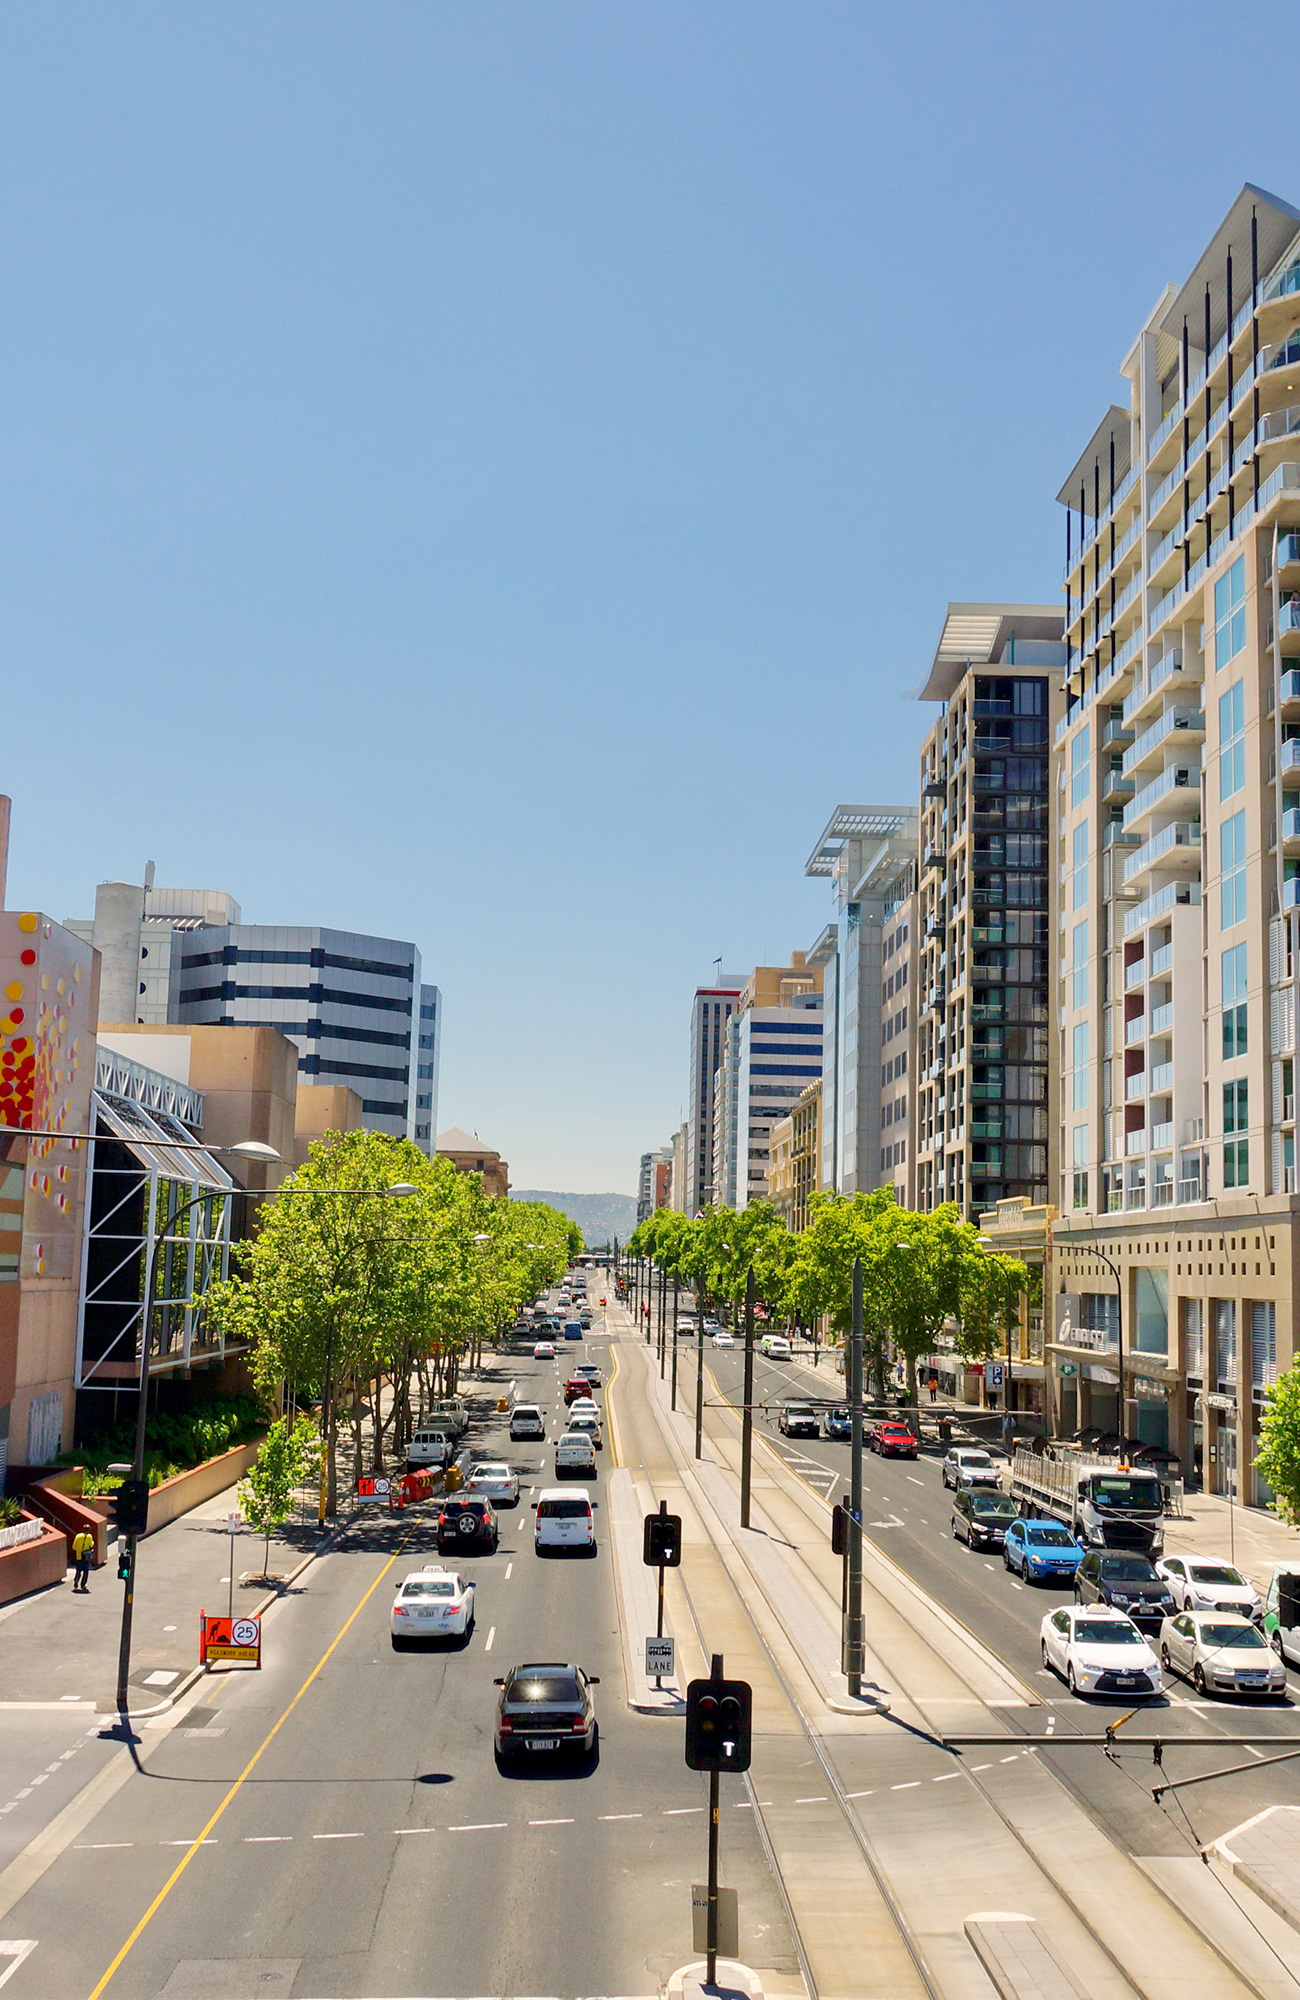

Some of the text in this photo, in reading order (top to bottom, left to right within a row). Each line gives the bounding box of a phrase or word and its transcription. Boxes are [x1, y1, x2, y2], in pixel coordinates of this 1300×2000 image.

[1064, 1366, 1072, 1374] P
[377, 1482, 388, 1490] 25
[236, 1626, 253, 1639] 25
[648, 1661, 671, 1671] LANE
